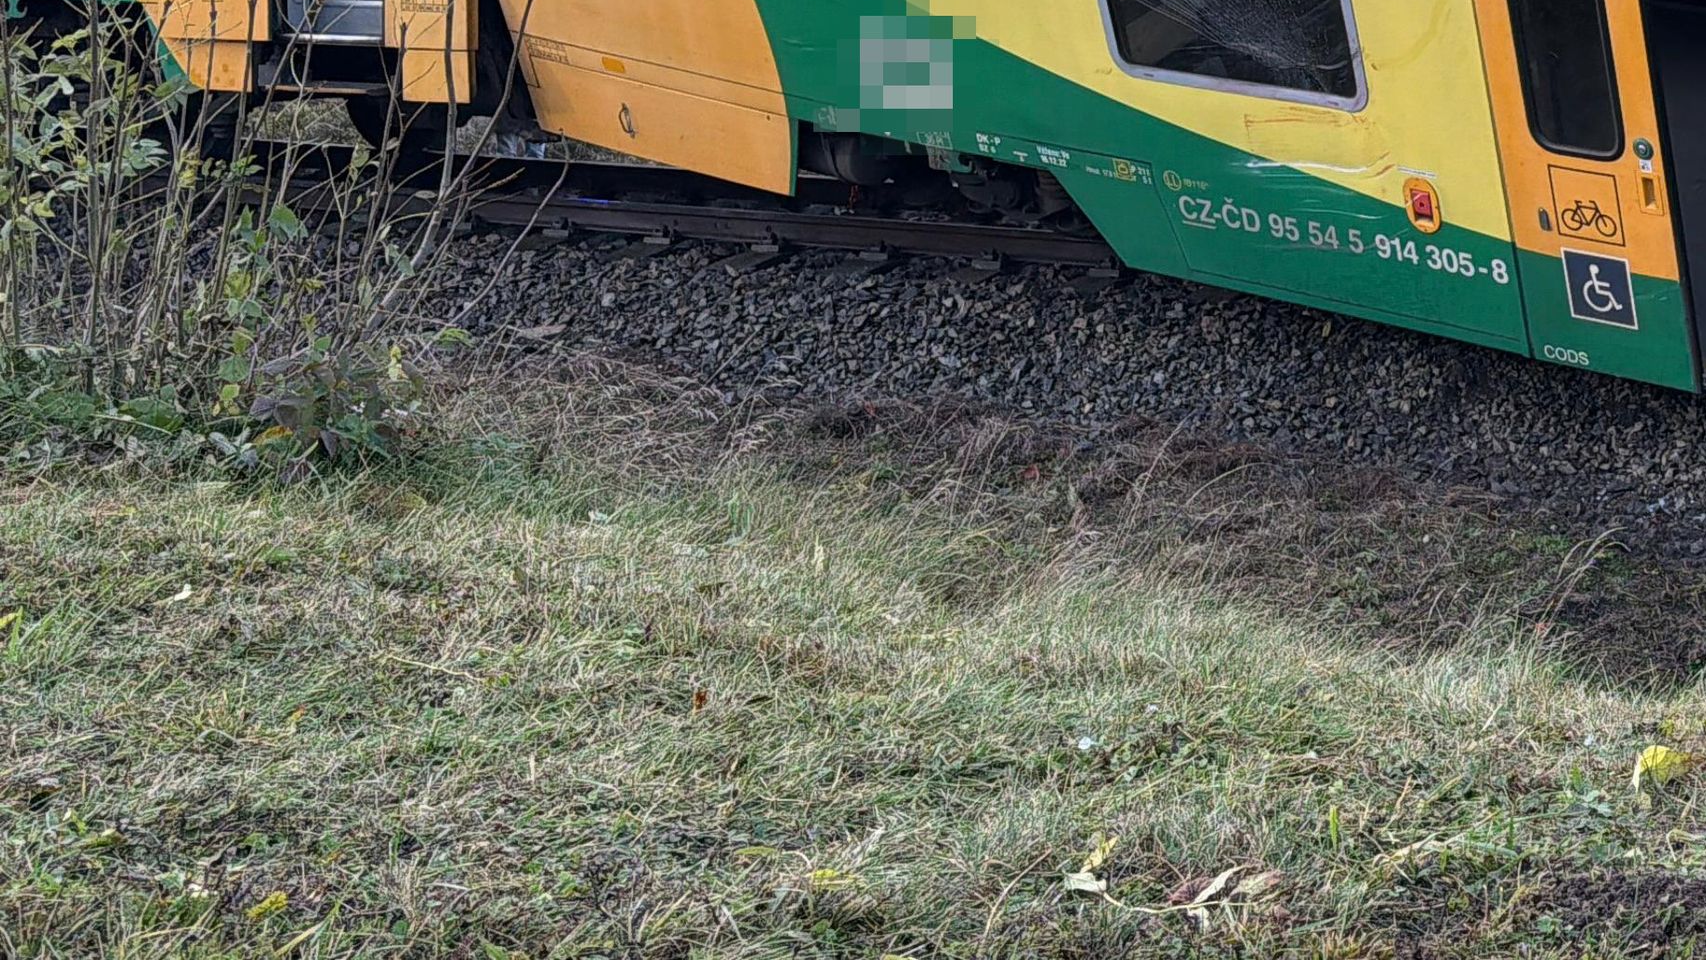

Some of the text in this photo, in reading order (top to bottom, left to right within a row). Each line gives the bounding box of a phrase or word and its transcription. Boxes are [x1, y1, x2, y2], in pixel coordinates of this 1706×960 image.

[1178, 195, 1261, 233] CZ-ČD
[1267, 212, 1300, 242] 95
[1308, 220, 1341, 249] 54
[1348, 228, 1365, 254] 5
[1374, 233, 1420, 266] 914
[1543, 344, 1590, 366] CODS
